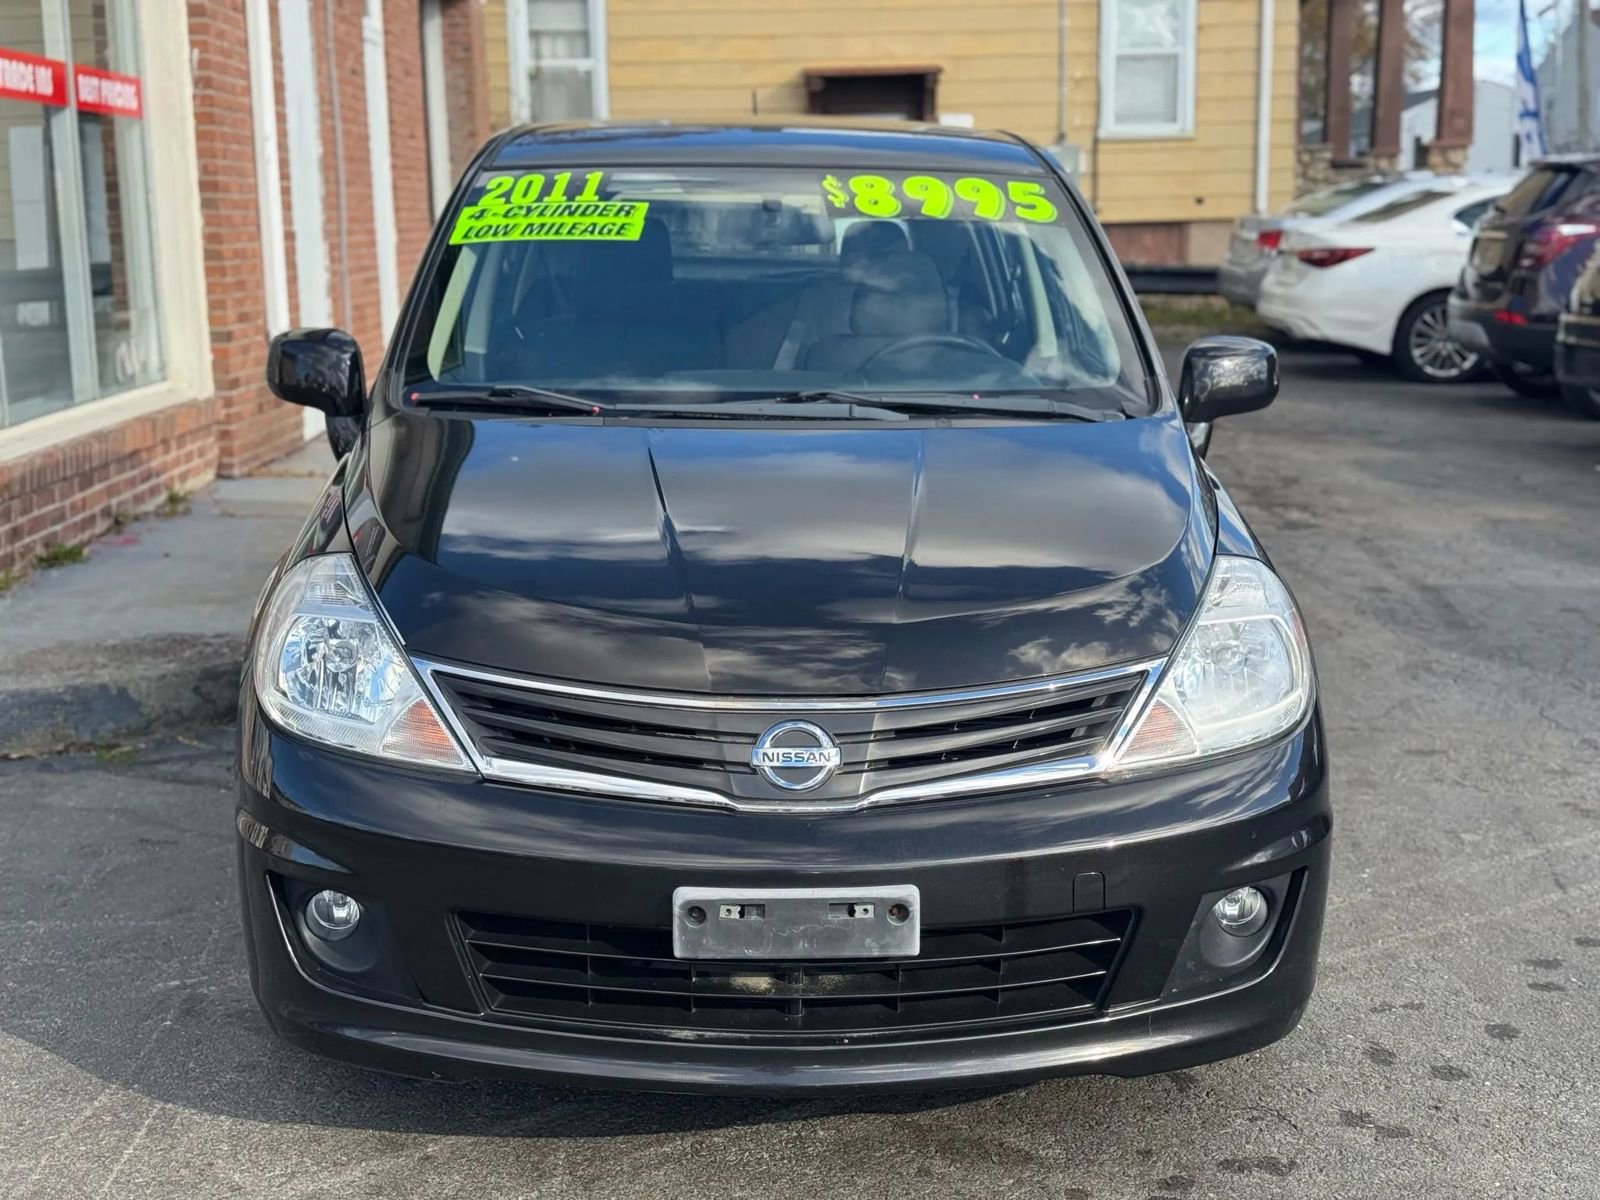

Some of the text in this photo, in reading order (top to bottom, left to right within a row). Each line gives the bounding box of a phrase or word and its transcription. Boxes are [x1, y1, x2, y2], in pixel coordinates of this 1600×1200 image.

[477, 171, 604, 206] 2011
[821, 173, 1058, 222] $8995
[468, 203, 637, 221] 4-CYLINDER
[462, 222, 631, 240] LOW MILEAGE
[762, 751, 831, 763] NISSAN
